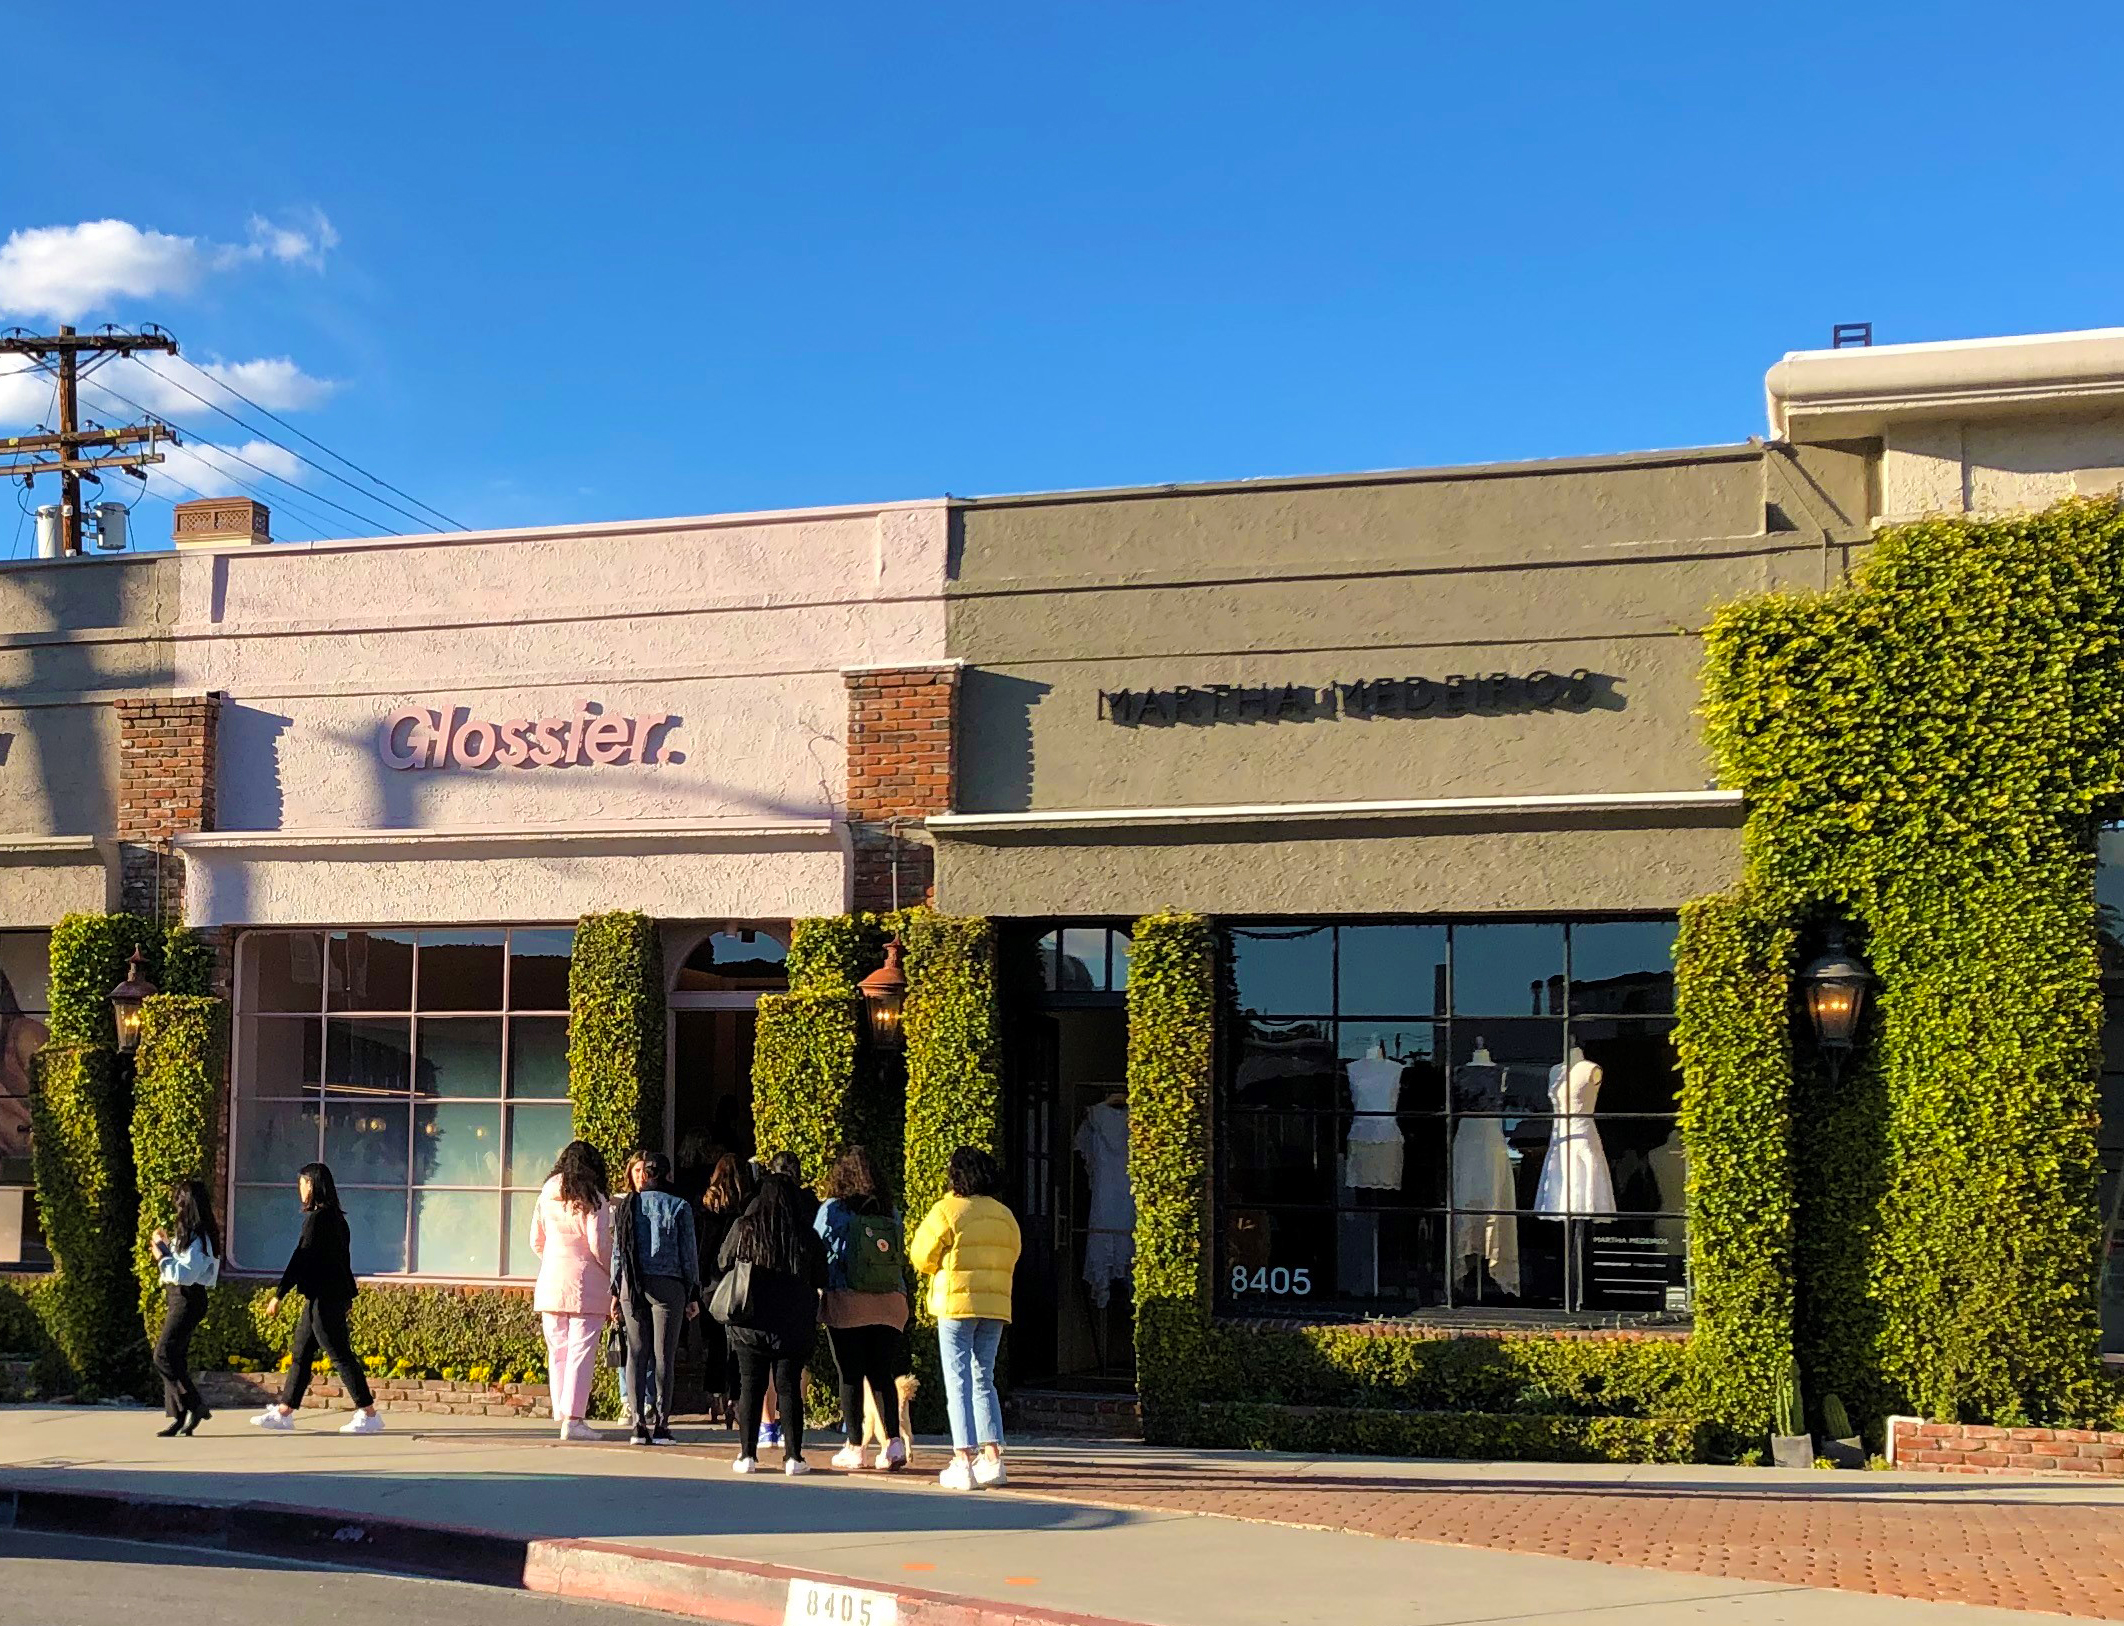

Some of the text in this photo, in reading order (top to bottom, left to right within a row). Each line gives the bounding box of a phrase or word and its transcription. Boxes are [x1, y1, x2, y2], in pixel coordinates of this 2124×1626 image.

[1097, 681, 1304, 721] MARTHA
[378, 698, 670, 770] Glossier.
[1231, 1265, 1311, 1295] 8405
[806, 1589, 872, 1626] 8405
